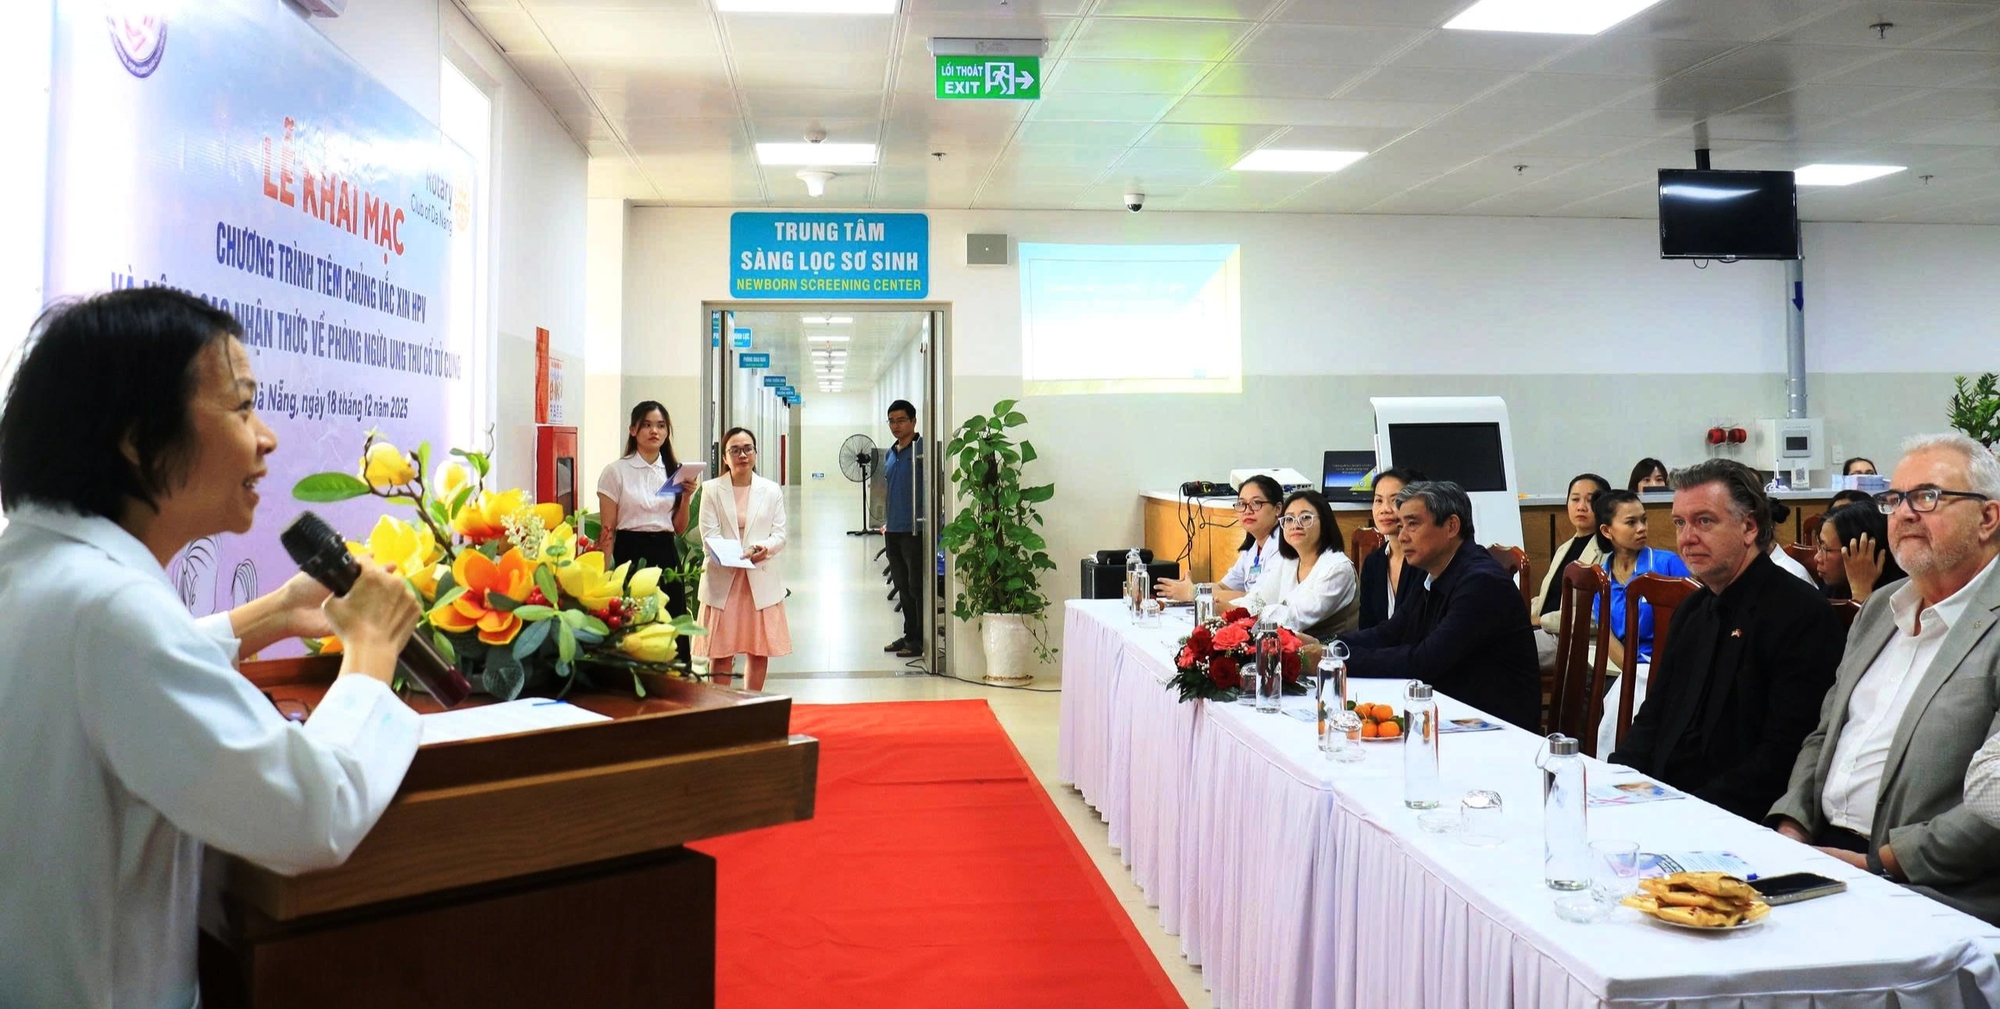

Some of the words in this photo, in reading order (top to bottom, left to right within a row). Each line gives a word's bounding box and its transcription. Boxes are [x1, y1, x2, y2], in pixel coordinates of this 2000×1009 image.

[941, 62, 954, 77] LỐI
[956, 64, 984, 77] THOÁT
[944, 81, 980, 95] EXIT
[303, 168, 358, 236] KHAI
[364, 191, 405, 266] MẠC
[411, 192, 424, 218] Club
[431, 204, 438, 226] Da
[439, 209, 452, 237] Nang
[774, 221, 839, 242] TRUNG
[843, 218, 885, 242] TÂM
[216, 221, 275, 280] CHƯƠNG
[278, 240, 314, 291] TRÌNH
[317, 253, 342, 300] TIÊM
[345, 261, 376, 310] CHỦNG
[379, 270, 395, 315] VẮC
[397, 286, 410, 320] XIN
[411, 292, 427, 324] HPV
[740, 247, 794, 271] SÀNG
[799, 251, 835, 275] LỌC
[841, 250, 867, 271] SƠ
[871, 252, 918, 271] SINH
[736, 278, 797, 291] NEWBORN
[800, 278, 870, 291] SCREENING
[873, 278, 922, 291] CENTER
[234, 298, 273, 356] NHẬN
[277, 307, 308, 355] THỨC
[312, 310, 325, 357] VỀ
[328, 319, 361, 364] PHÒNG
[364, 328, 387, 368] NGỪA
[389, 338, 406, 372] UNG
[408, 342, 423, 374] THƯ
[423, 337, 432, 376] CỔ
[434, 341, 443, 378] TỬ
[444, 351, 461, 380] CUNG
[267, 379, 299, 420] Nẵng,
[301, 388, 325, 421] ngày
[327, 389, 337, 415] 18
[338, 392, 362, 422] tháng
[364, 393, 373, 417] 12
[373, 395, 389, 418] năm
[390, 397, 408, 419] 2025
